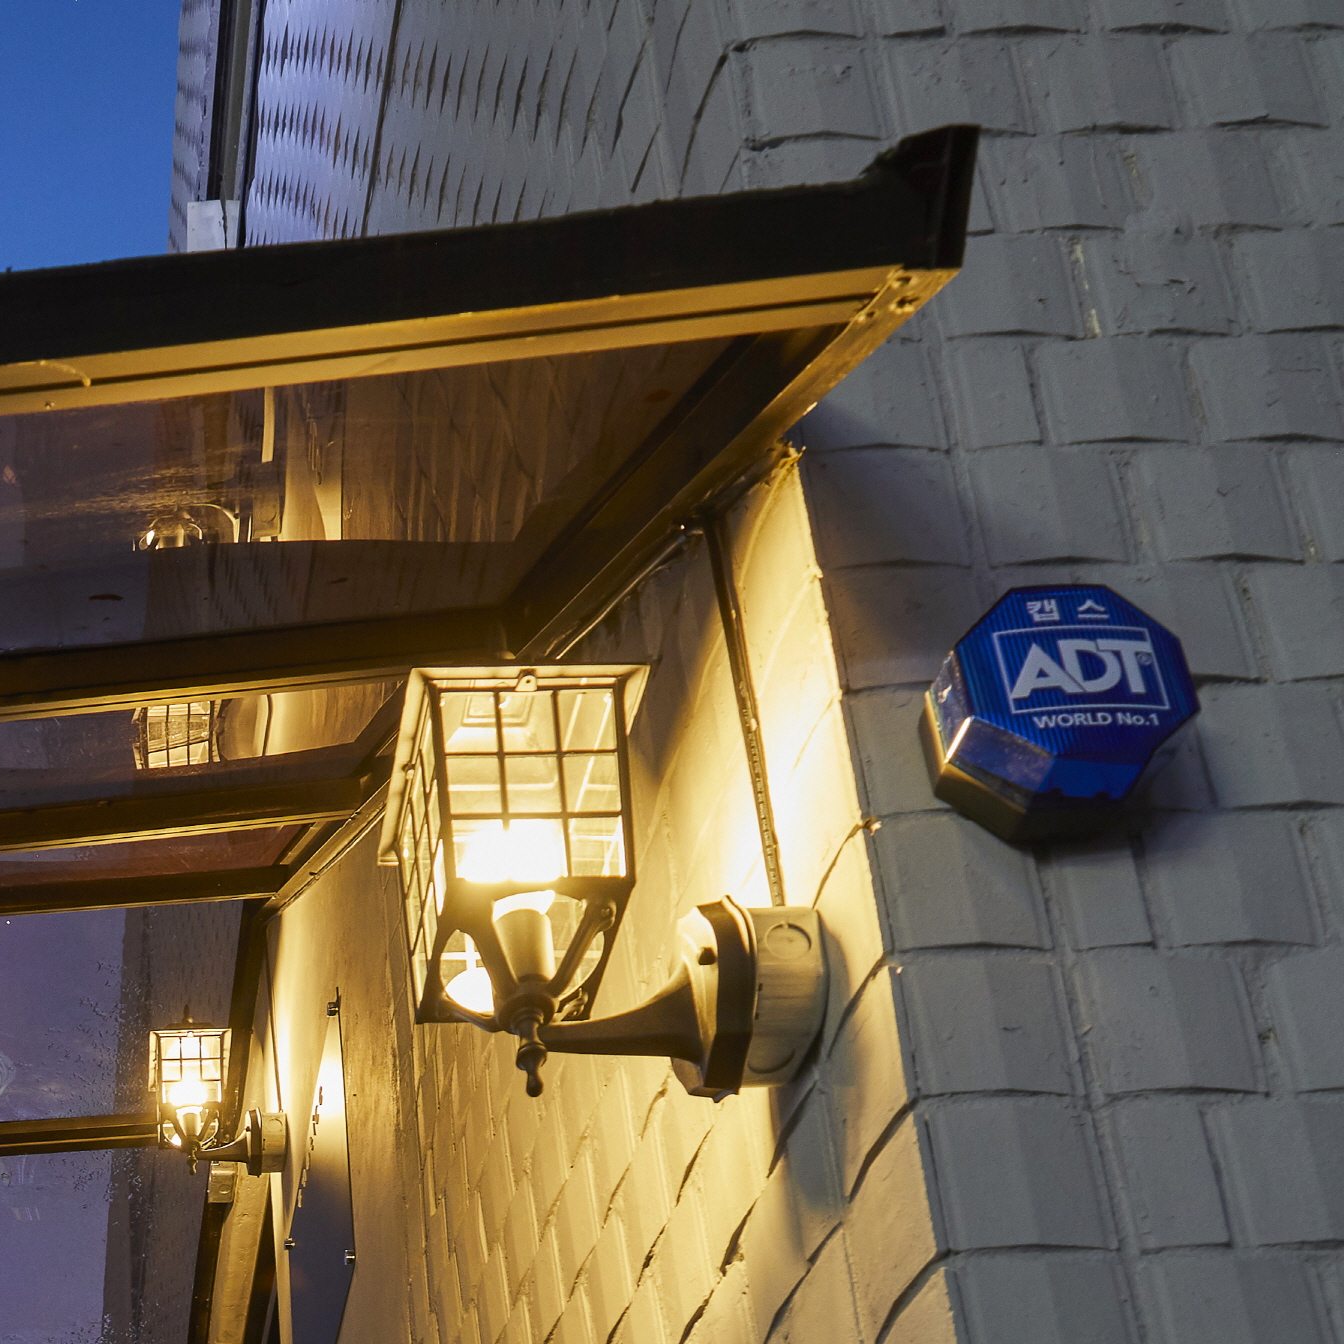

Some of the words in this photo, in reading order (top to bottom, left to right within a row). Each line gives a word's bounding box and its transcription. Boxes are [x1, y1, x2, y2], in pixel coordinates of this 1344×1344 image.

[1010, 638, 1153, 699] ADT
[1032, 712, 1112, 729] WORLD
[1116, 712, 1159, 726] No.1
